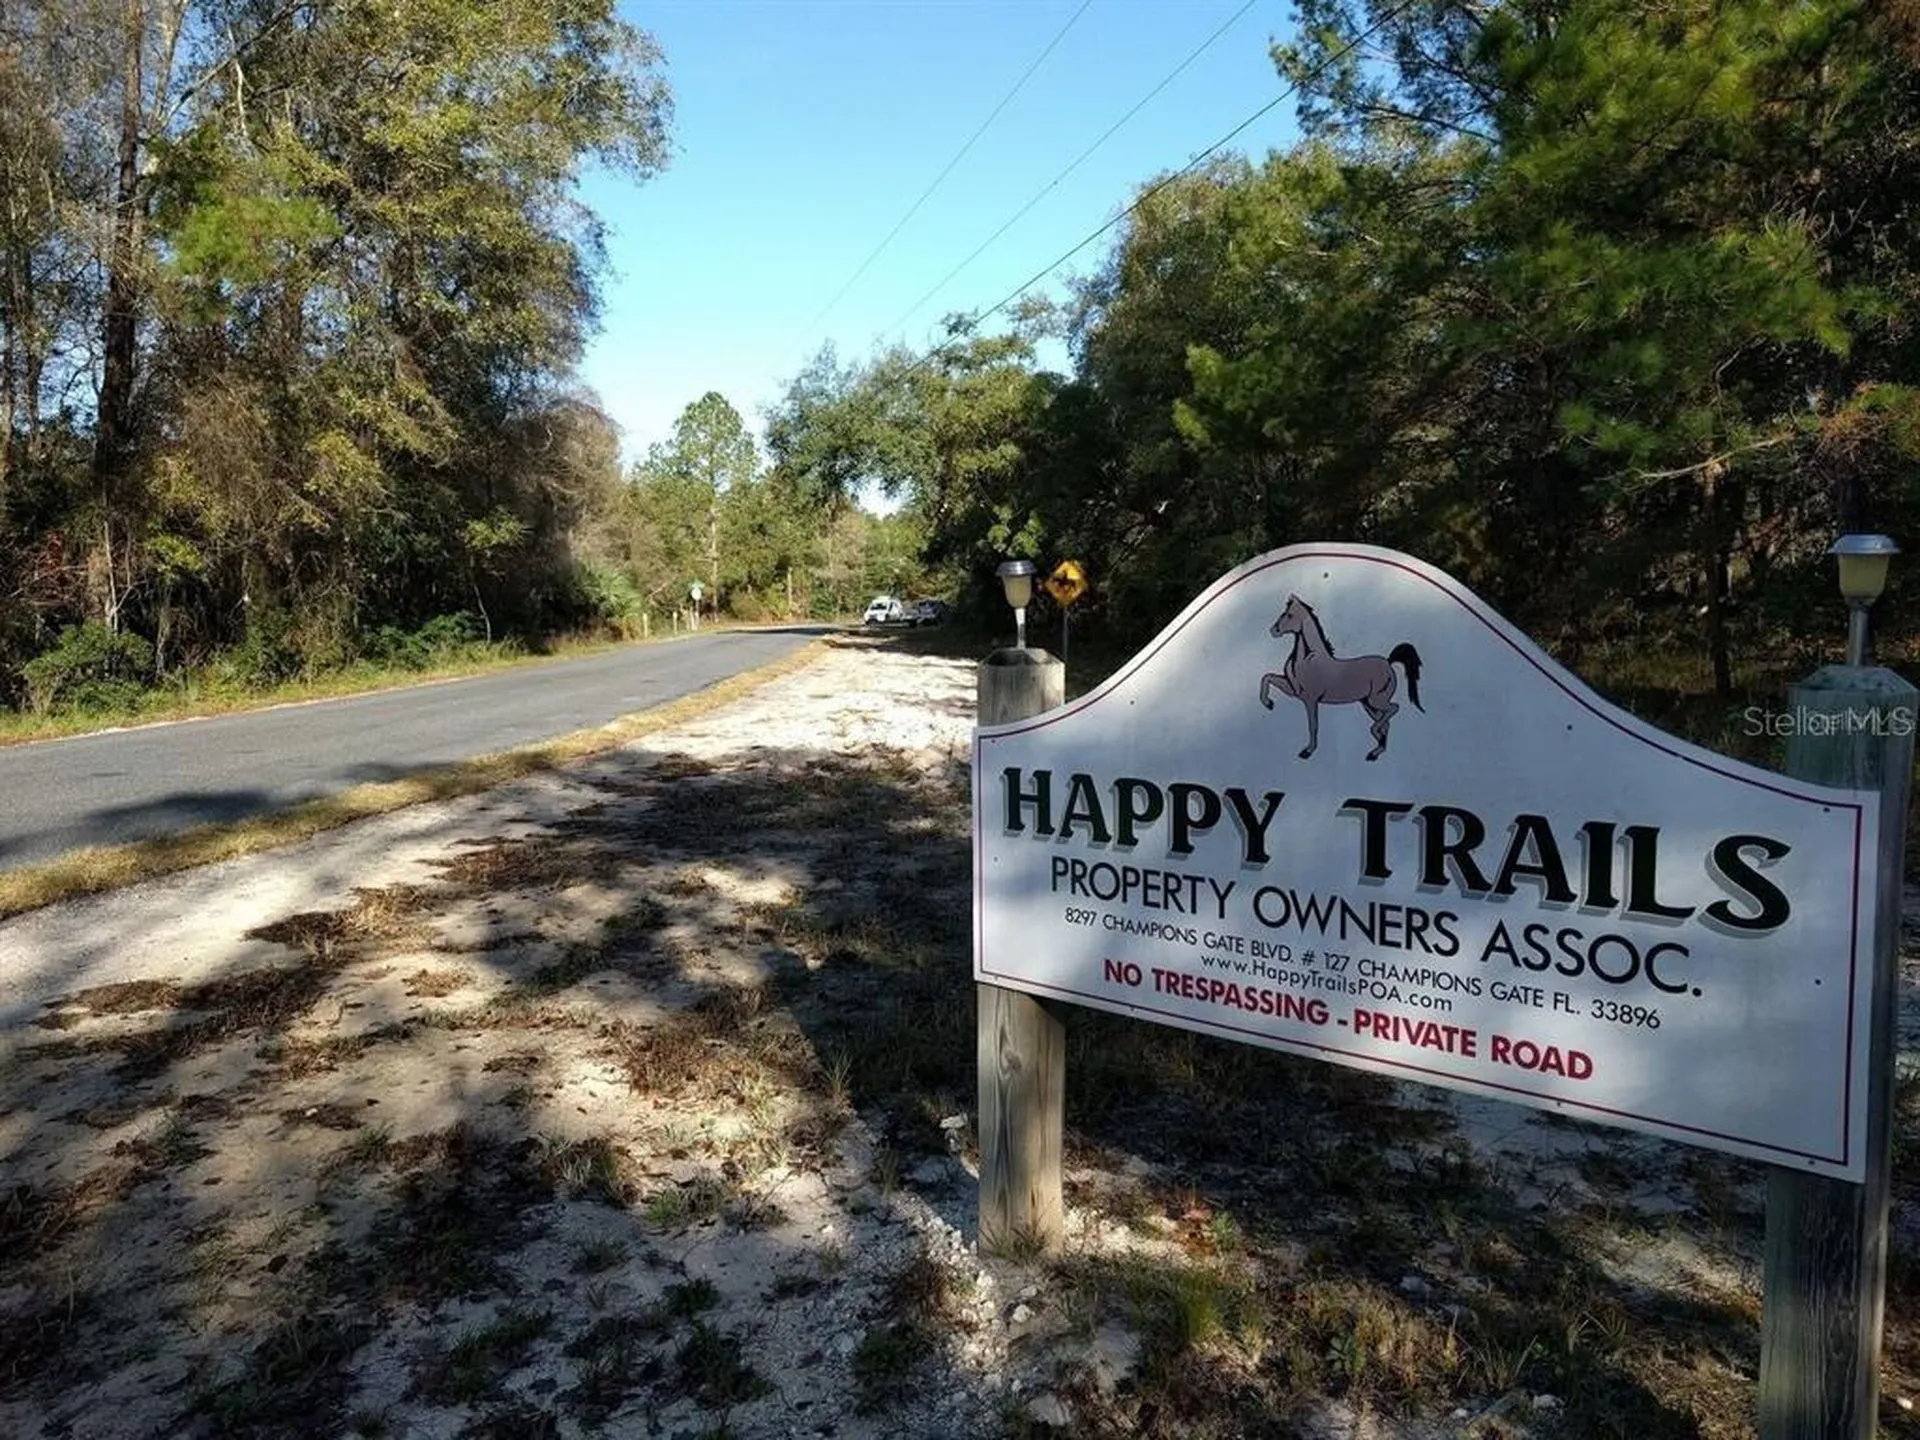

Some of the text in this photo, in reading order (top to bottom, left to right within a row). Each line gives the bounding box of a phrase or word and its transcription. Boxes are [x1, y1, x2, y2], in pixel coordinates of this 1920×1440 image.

[1002, 767, 1791, 939] HAPPY TRAILS
[1051, 856, 1703, 997] PROPERTY OWNERS ASSOC.
[1065, 907, 1661, 1030] 8297 CHAMPIONS GATE BLVD. # 127 CHAMPIONS GATE FL. 33896
[1200, 954, 1453, 1013] www.HappyTrailsPOA.com
[1104, 958, 1143, 987] NO
[1151, 968, 1329, 1026] TRESPASSING
[1353, 1008, 1477, 1058] PRIVATE
[1491, 1034, 1594, 1081] ROAD
